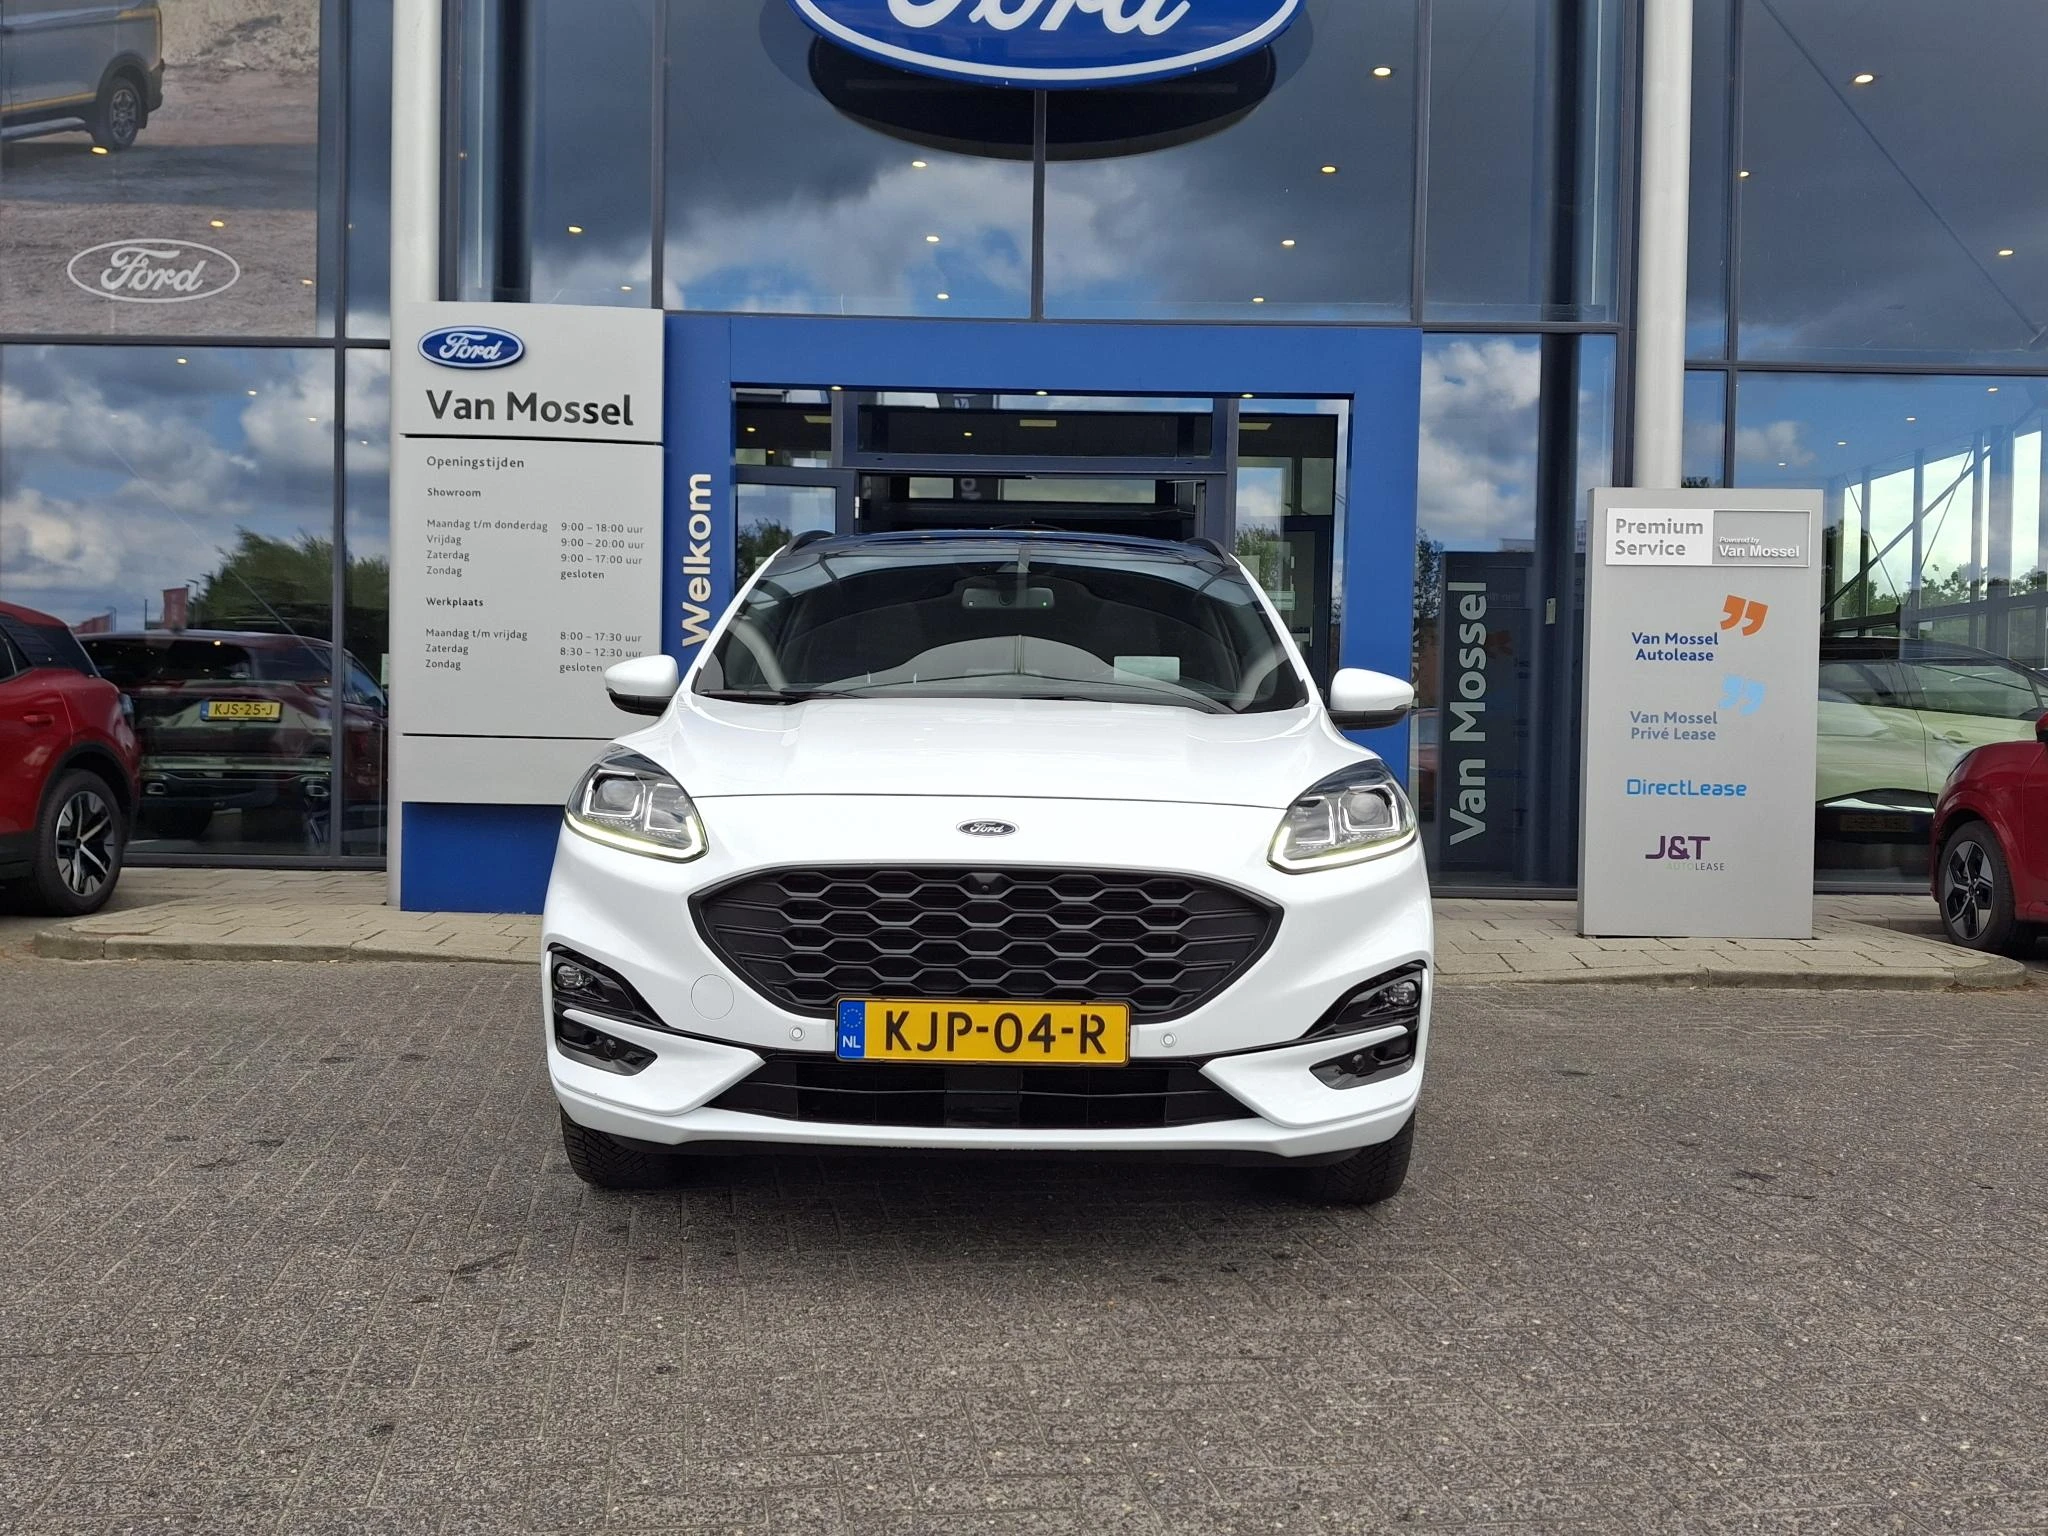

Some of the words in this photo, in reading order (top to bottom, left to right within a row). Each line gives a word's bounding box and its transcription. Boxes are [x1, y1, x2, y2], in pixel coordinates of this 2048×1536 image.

[101, 247, 207, 291] Ford
[439, 332, 502, 360] Ford
[426, 390, 494, 420] Van
[507, 392, 633, 425] Mossel
[427, 456, 524, 470] Openingstijden
[427, 488, 482, 497] Showroom
[427, 520, 471, 531] Maandag
[473, 520, 492, 529] t/m
[494, 521, 548, 533] donderdag
[561, 523, 584, 532] 9:00
[595, 524, 624, 533] 18:00
[1616, 518, 1703, 534] Premium
[426, 536, 462, 546] Vrijdag
[560, 538, 584, 547] 9:00
[595, 539, 625, 549] 20:00
[1718, 536, 1749, 545] Powered
[1749, 536, 1761, 545] by
[1616, 540, 1685, 555] Service
[1718, 545, 1747, 558] Van
[1749, 545, 1800, 558] Mossel
[427, 551, 470, 562] Zaterdag
[560, 554, 584, 563] 9:00
[595, 555, 623, 564] 17:00
[682, 474, 712, 646] Welkom
[426, 566, 463, 578] Zondag
[560, 570, 605, 580] gesloten
[426, 598, 484, 609] Werkplaats
[425, 629, 470, 640] Maandag
[472, 630, 491, 639] t/m
[493, 630, 528, 642] vrijdag
[560, 632, 583, 641] 8:00
[595, 633, 622, 642] 17:30
[1631, 632, 1660, 645] Van
[1665, 632, 1718, 645] Mossel
[425, 644, 469, 656] Zaterdag
[559, 647, 583, 656] 8:30
[594, 648, 623, 658] 12:30
[1636, 648, 1713, 661] Autolease
[425, 660, 462, 672] Zondag
[1448, 581, 1487, 742] Mossel
[559, 663, 603, 674] gesloten
[214, 704, 274, 716] KJS-25-J
[1629, 711, 1659, 724] Van
[1663, 712, 1718, 725] Mossel
[1631, 727, 1670, 740] Privé
[1673, 728, 1717, 741] Lease
[1627, 779, 1746, 796] DirectLease
[1450, 760, 1486, 845] Van
[969, 822, 1005, 834] Ford
[1645, 836, 1710, 859] J&T
[885, 1010, 1106, 1054] KJP-04-R
[843, 1035, 861, 1049] NL
